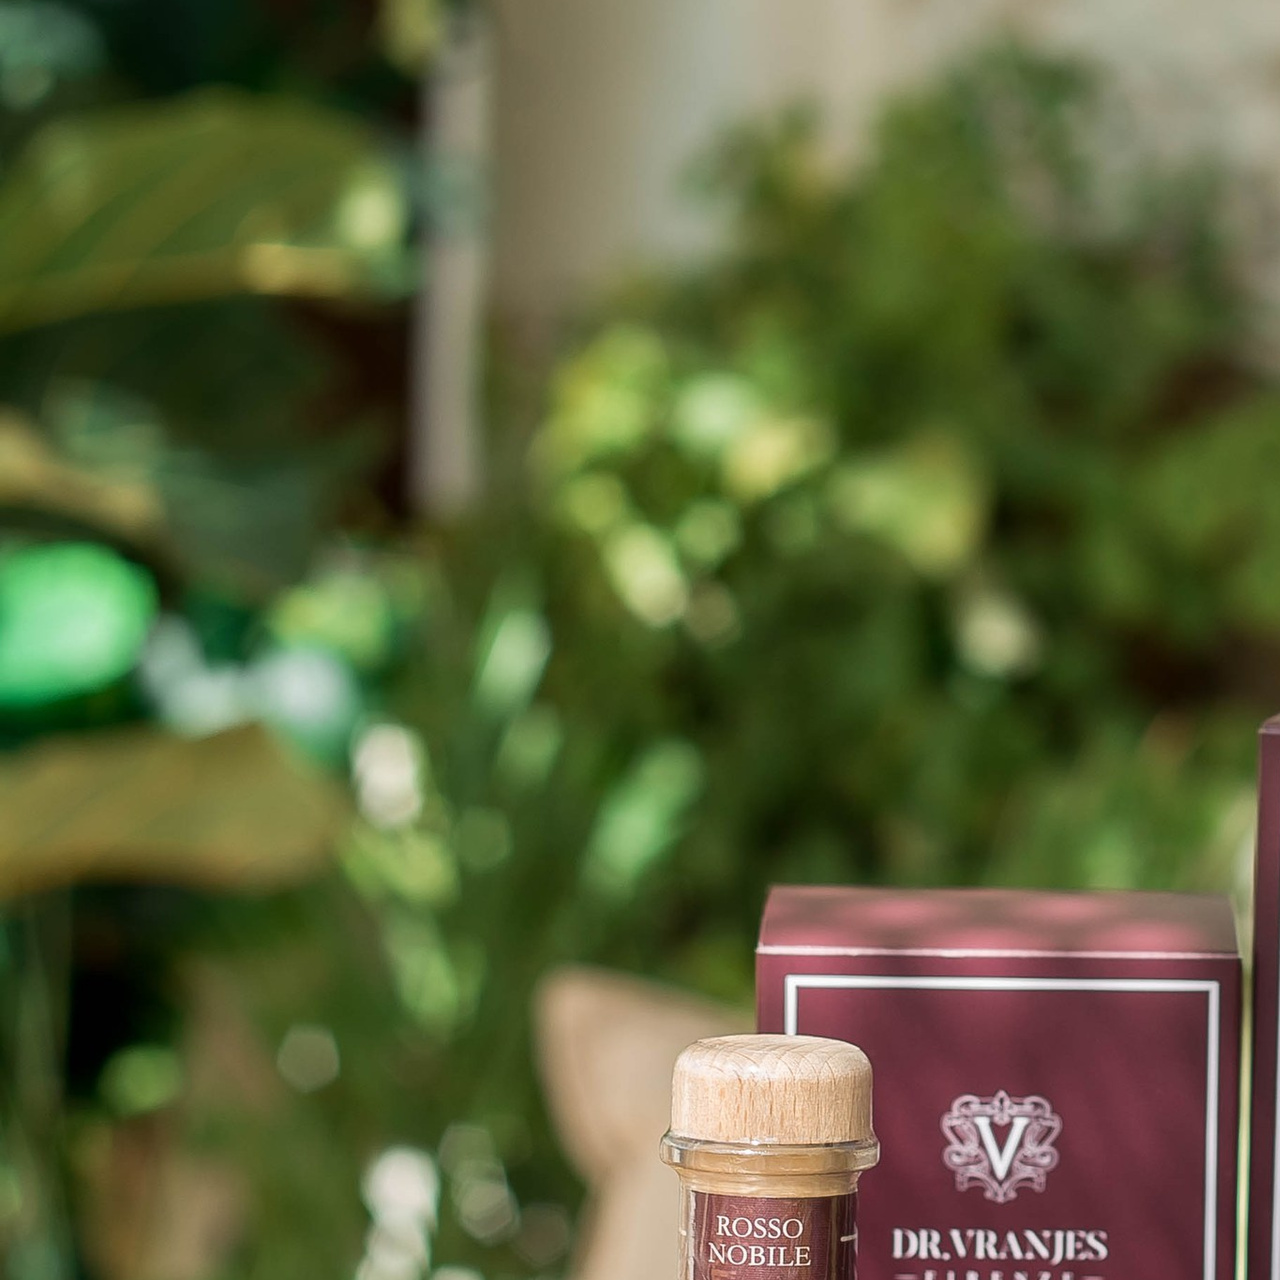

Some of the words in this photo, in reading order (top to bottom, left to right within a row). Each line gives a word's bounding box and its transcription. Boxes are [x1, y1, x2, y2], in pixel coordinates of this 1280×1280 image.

[715, 1215, 804, 1239] ROSSO
[707, 1242, 812, 1267] NOBILE
[892, 1227, 1109, 1266] DR.VRANJES
